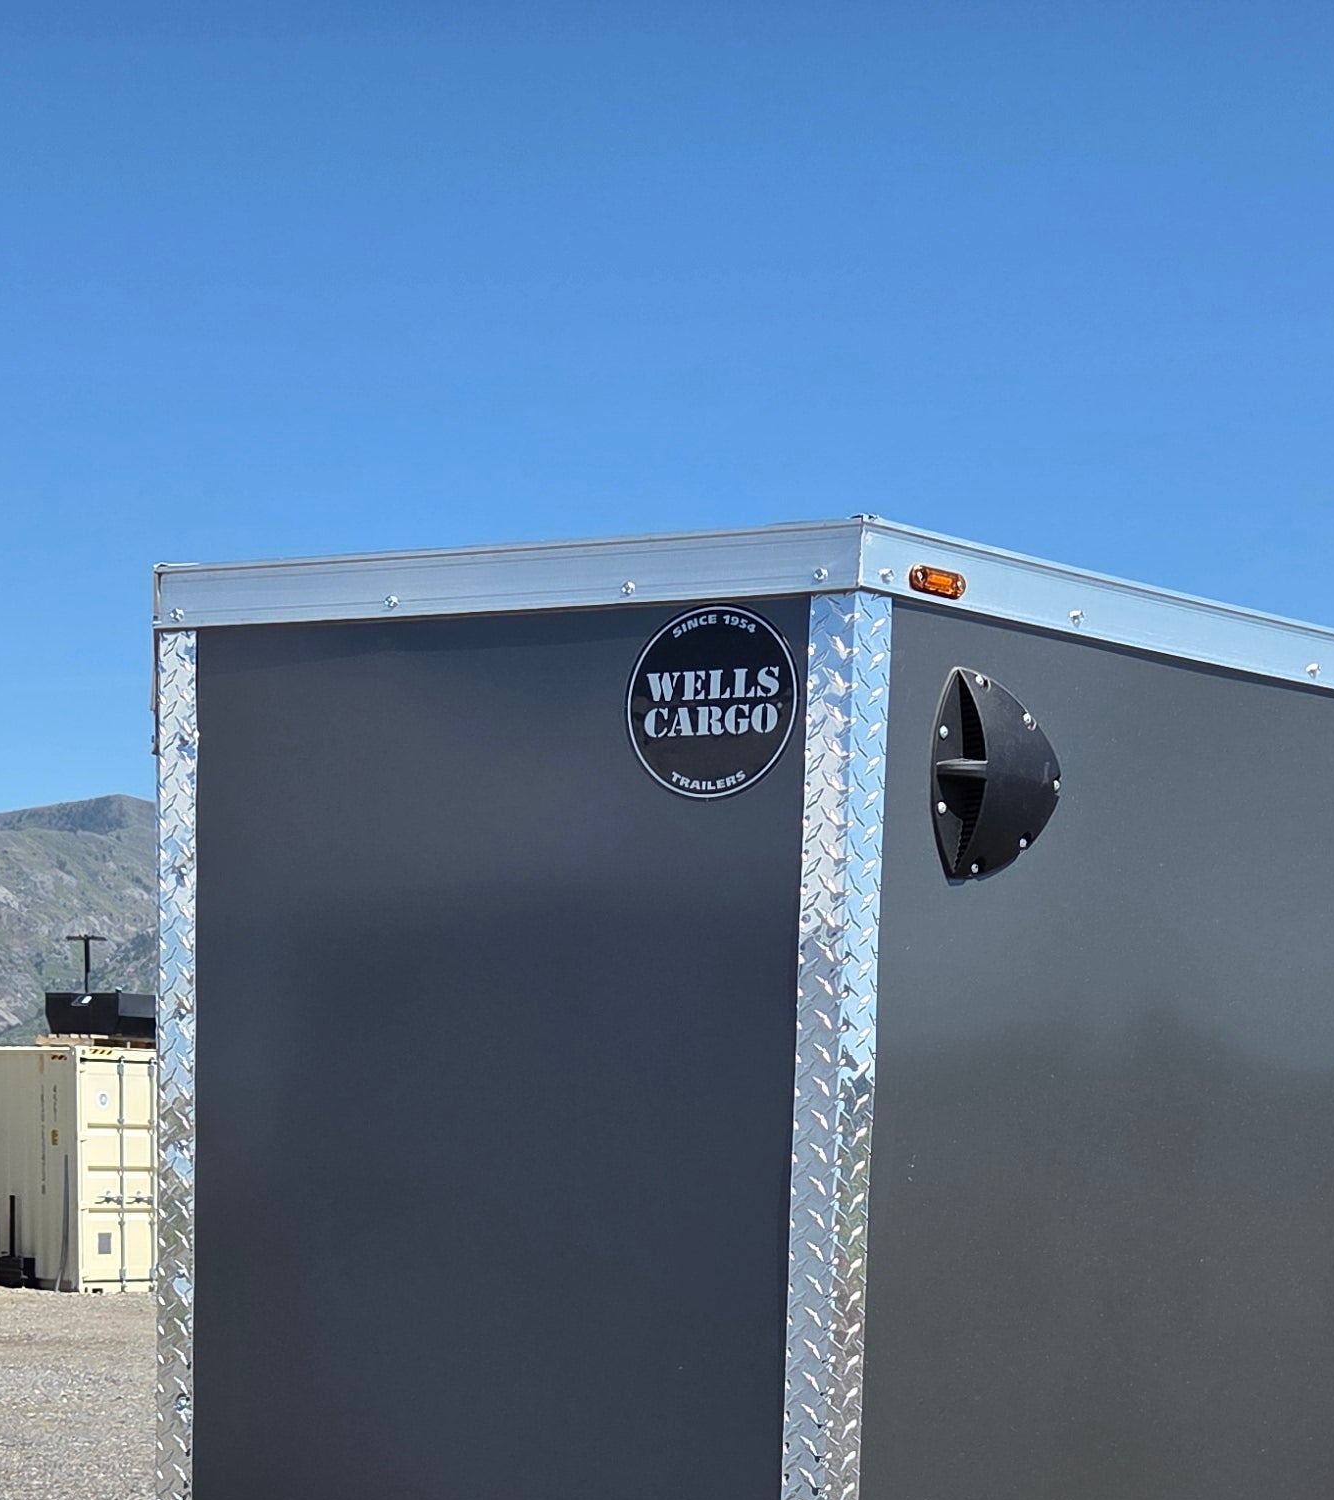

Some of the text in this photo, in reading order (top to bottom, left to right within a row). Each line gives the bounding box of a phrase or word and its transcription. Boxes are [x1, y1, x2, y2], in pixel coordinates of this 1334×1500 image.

[673, 614, 756, 638] SINCE 1954
[647, 666, 780, 701] WELLS
[644, 703, 778, 738] CARGO
[672, 770, 746, 790] TRAILERS
